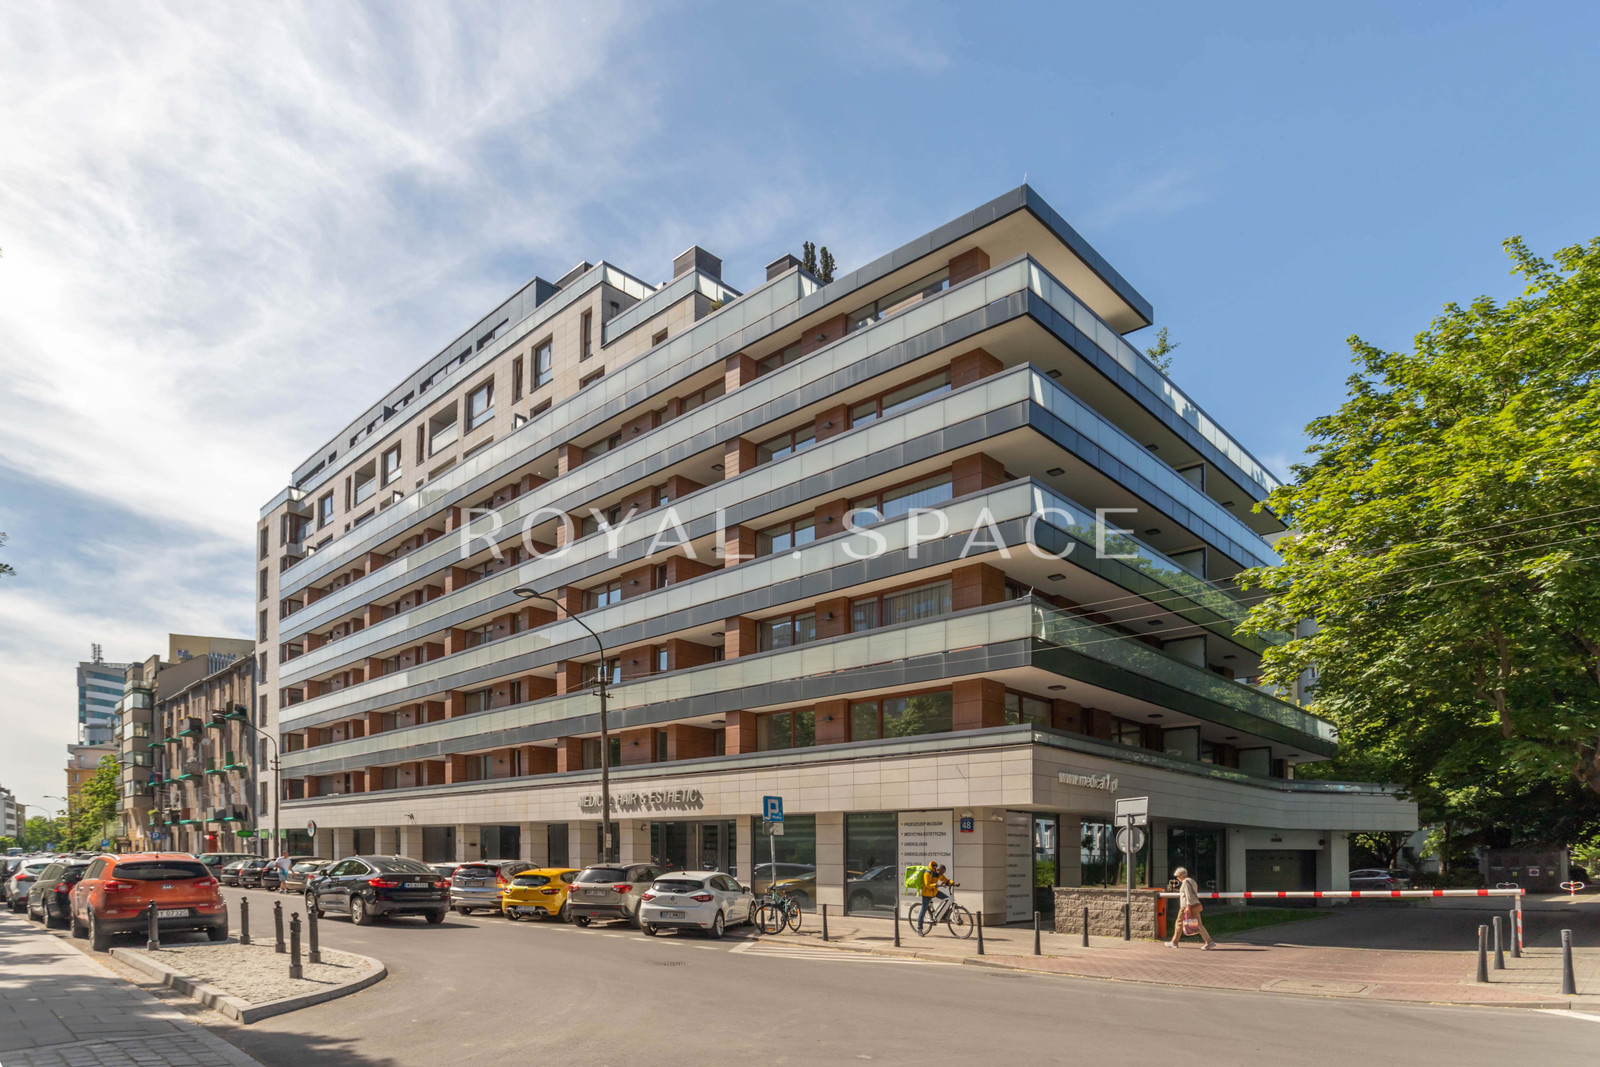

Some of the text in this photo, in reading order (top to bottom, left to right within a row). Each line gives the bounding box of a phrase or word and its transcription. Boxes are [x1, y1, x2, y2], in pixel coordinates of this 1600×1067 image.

[617, 792, 638, 805] HAIR
[650, 788, 699, 804] ESTHETIC
[961, 821, 972, 830] 48
